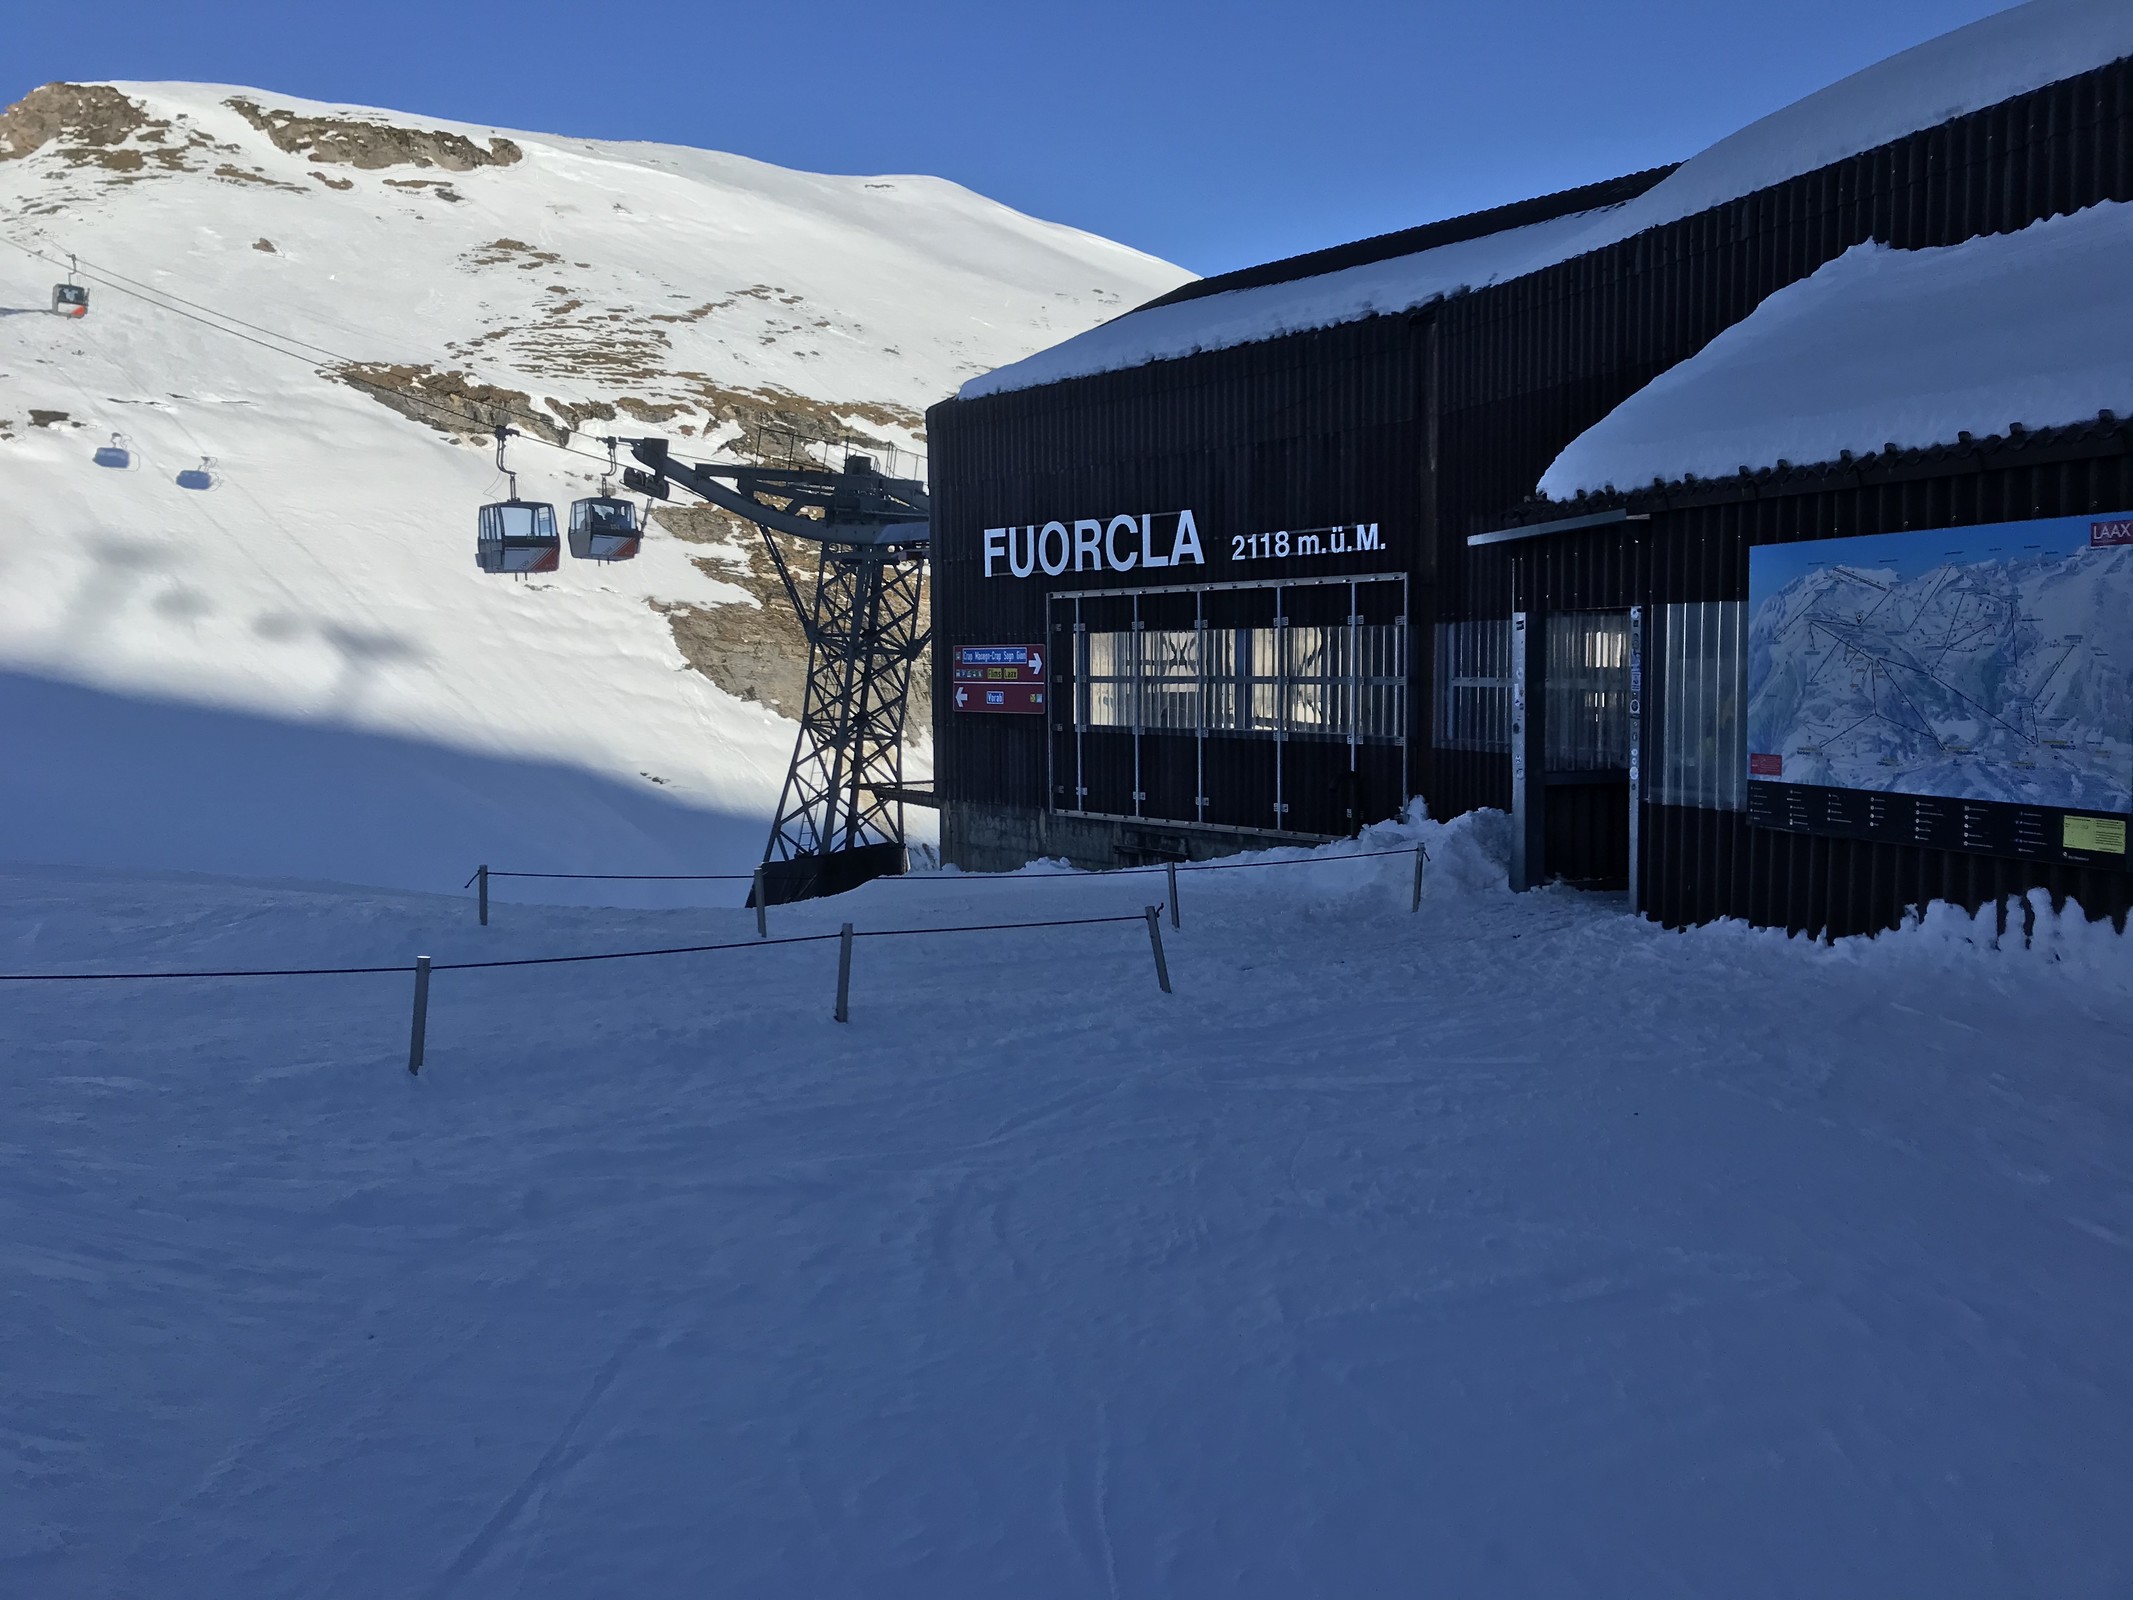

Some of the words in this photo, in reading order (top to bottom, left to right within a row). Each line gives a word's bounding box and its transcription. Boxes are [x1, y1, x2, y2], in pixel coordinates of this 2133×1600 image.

[984, 509, 1205, 578] FUORCLA
[1232, 530, 1290, 561] 2118
[1297, 522, 1387, 556] m.ü.M.
[2093, 522, 2131, 540] LAAX
